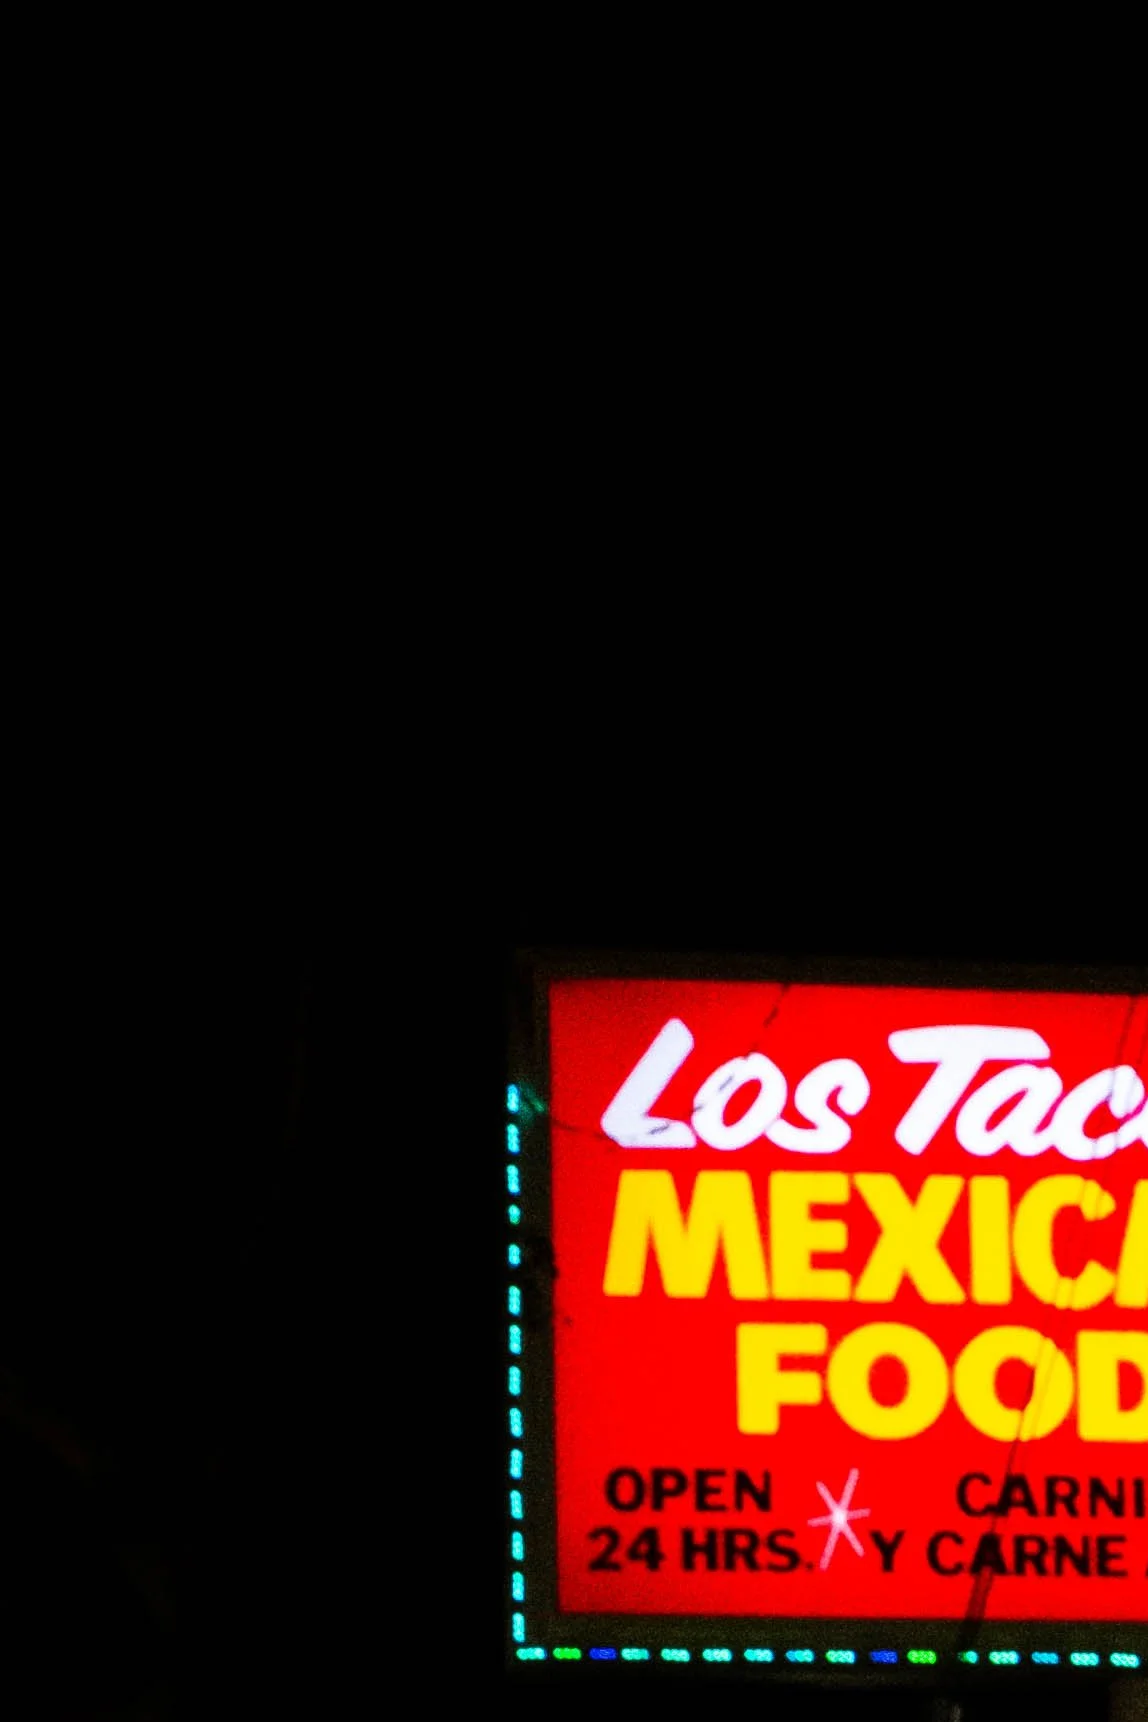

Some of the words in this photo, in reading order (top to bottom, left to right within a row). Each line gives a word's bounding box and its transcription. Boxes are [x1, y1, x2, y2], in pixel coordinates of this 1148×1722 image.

[601, 1017, 870, 1154] Los
[604, 1467, 772, 1513] OPEN
[586, 1526, 665, 1573] 24
[681, 1528, 816, 1573] HRS.
[870, 1531, 906, 1574] Y
[926, 1530, 1125, 1579] CARNE
